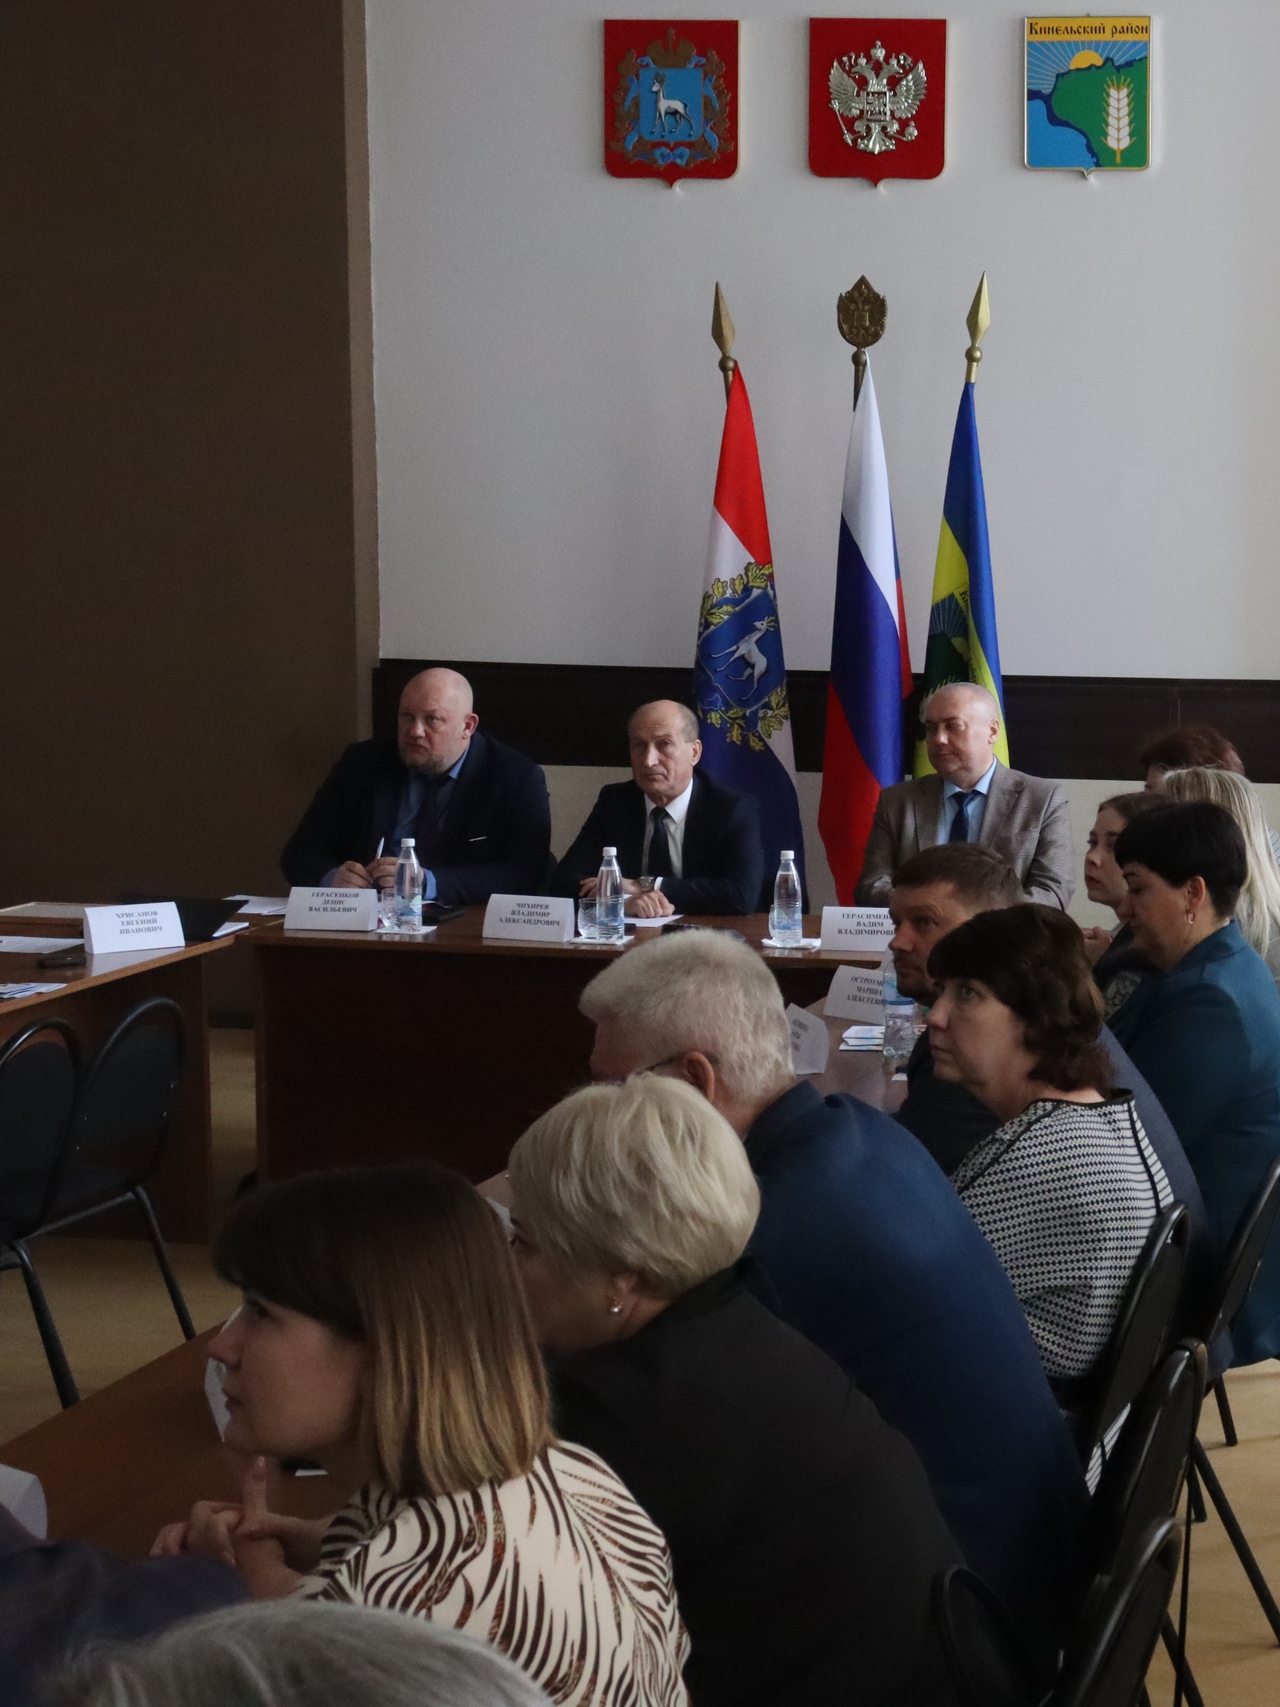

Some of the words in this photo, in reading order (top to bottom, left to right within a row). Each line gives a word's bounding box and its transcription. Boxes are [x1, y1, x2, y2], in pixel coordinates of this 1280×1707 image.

[1029, 22, 1106, 35] Кинельский
[1111, 22, 1149, 38] район
[115, 910, 159, 919] ХРИСАНОВ
[510, 909, 551, 918] ВЛАДИМИР
[121, 917, 158, 927] ЕВГЕНИЙ
[498, 917, 561, 927] АЛЕКСАНДРОВИЧ
[119, 926, 163, 935] ИВАНОВИЧ
[856, 986, 882, 996] МАРИНА
